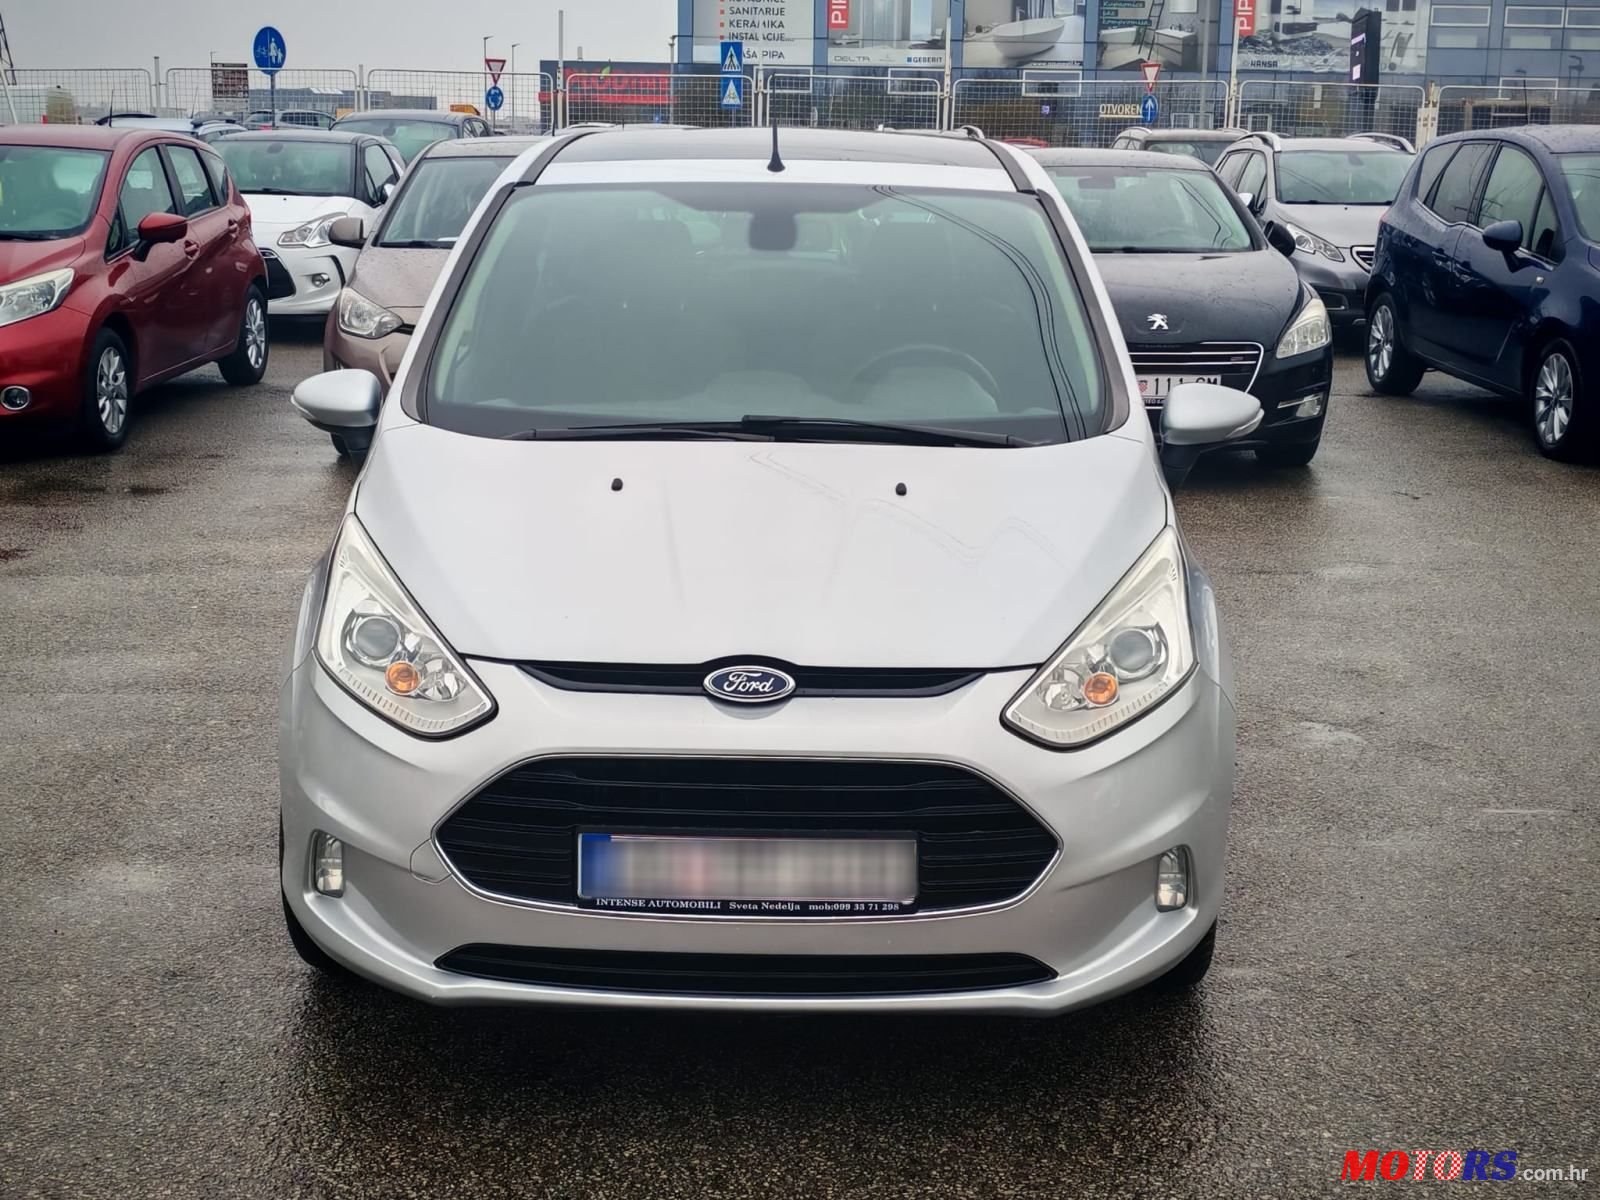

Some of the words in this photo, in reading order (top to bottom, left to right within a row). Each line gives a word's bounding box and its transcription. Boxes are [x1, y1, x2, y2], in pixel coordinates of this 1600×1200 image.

[729, 6, 786, 16] SANITARIJE
[729, 19, 785, 28] KERAMIKA
[913, 56, 943, 64] GEBERIT
[1099, 103, 1143, 115] OTVOREN
[723, 671, 774, 693] Ford
[596, 898, 646, 907] INTENSE
[648, 900, 721, 909] AUTOMOBILI
[729, 901, 758, 910] Sveta
[761, 902, 801, 911] Nedelja
[868, 903, 879, 911] 71
[882, 903, 900, 911] 298
